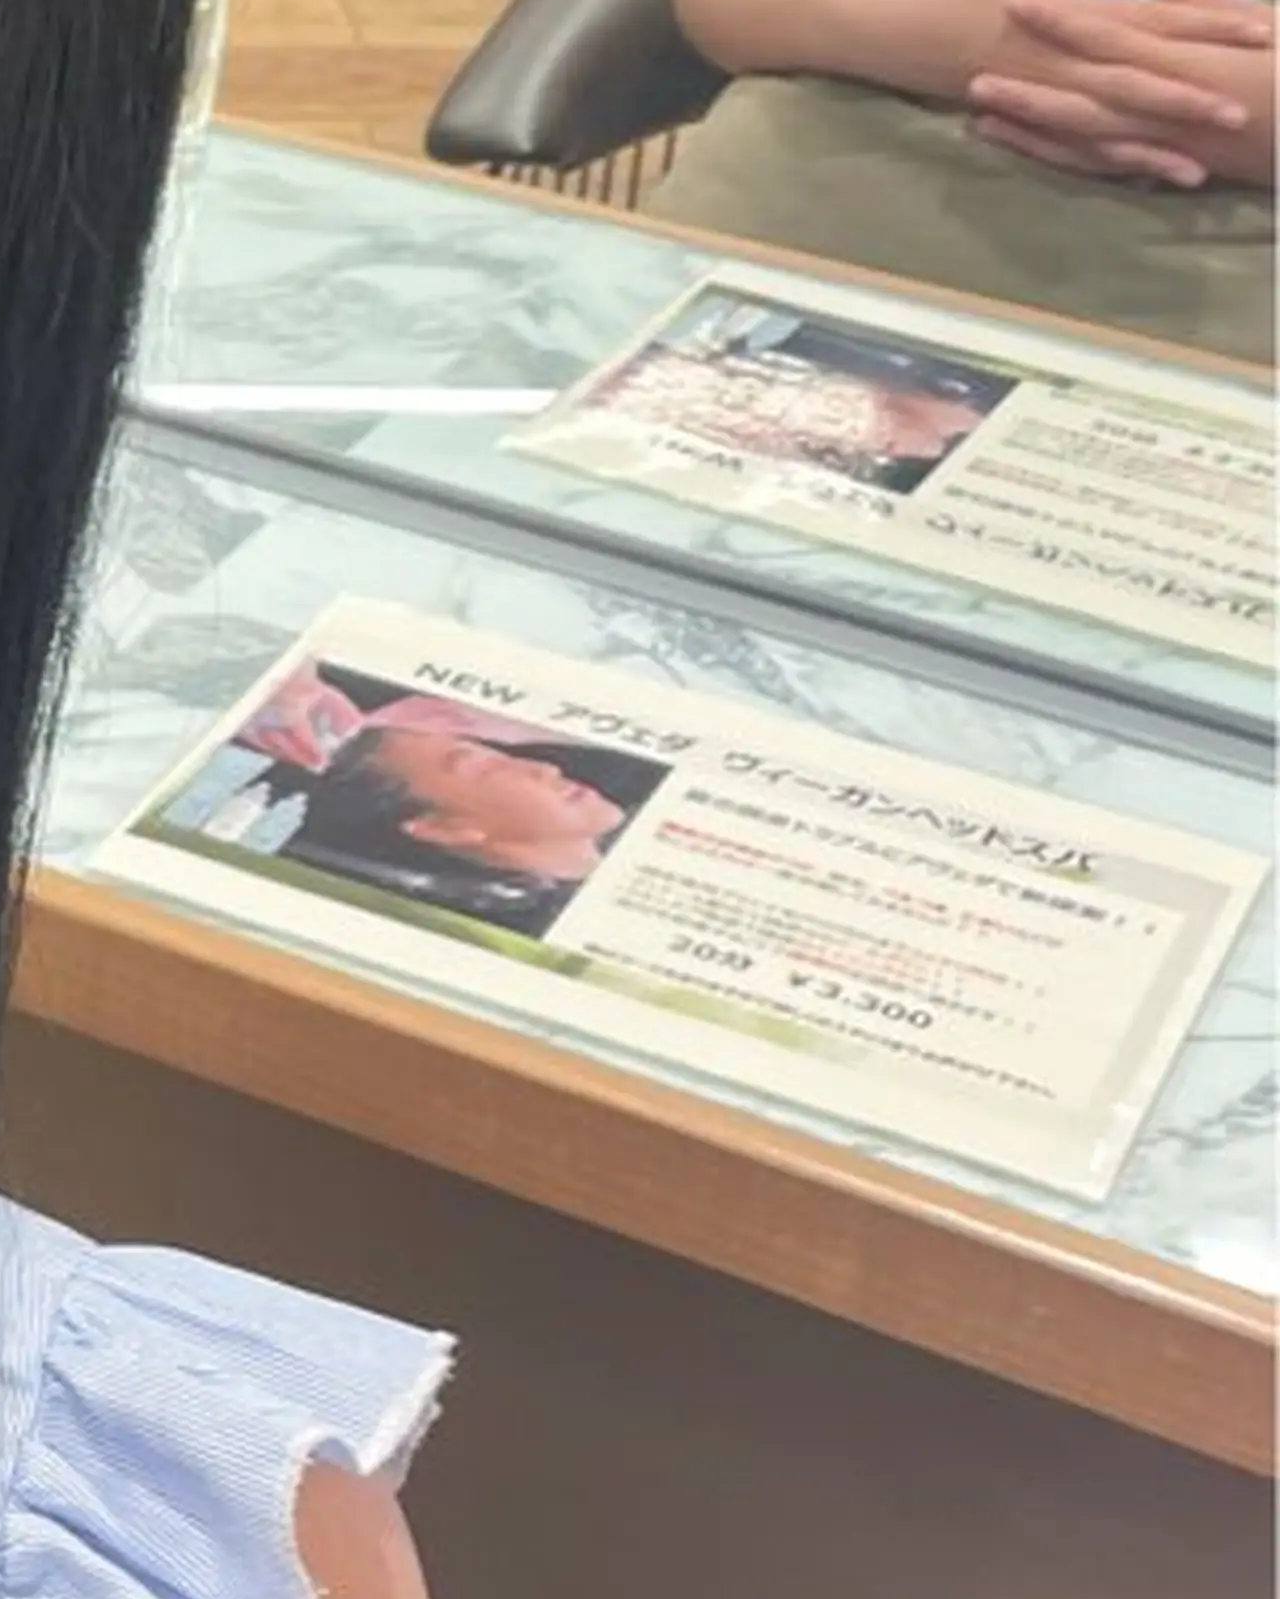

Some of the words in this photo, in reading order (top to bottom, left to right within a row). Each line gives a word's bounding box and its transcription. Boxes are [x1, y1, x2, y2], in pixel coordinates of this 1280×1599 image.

[414, 661, 526, 704] NEW
[547, 700, 699, 751] アヴェダ
